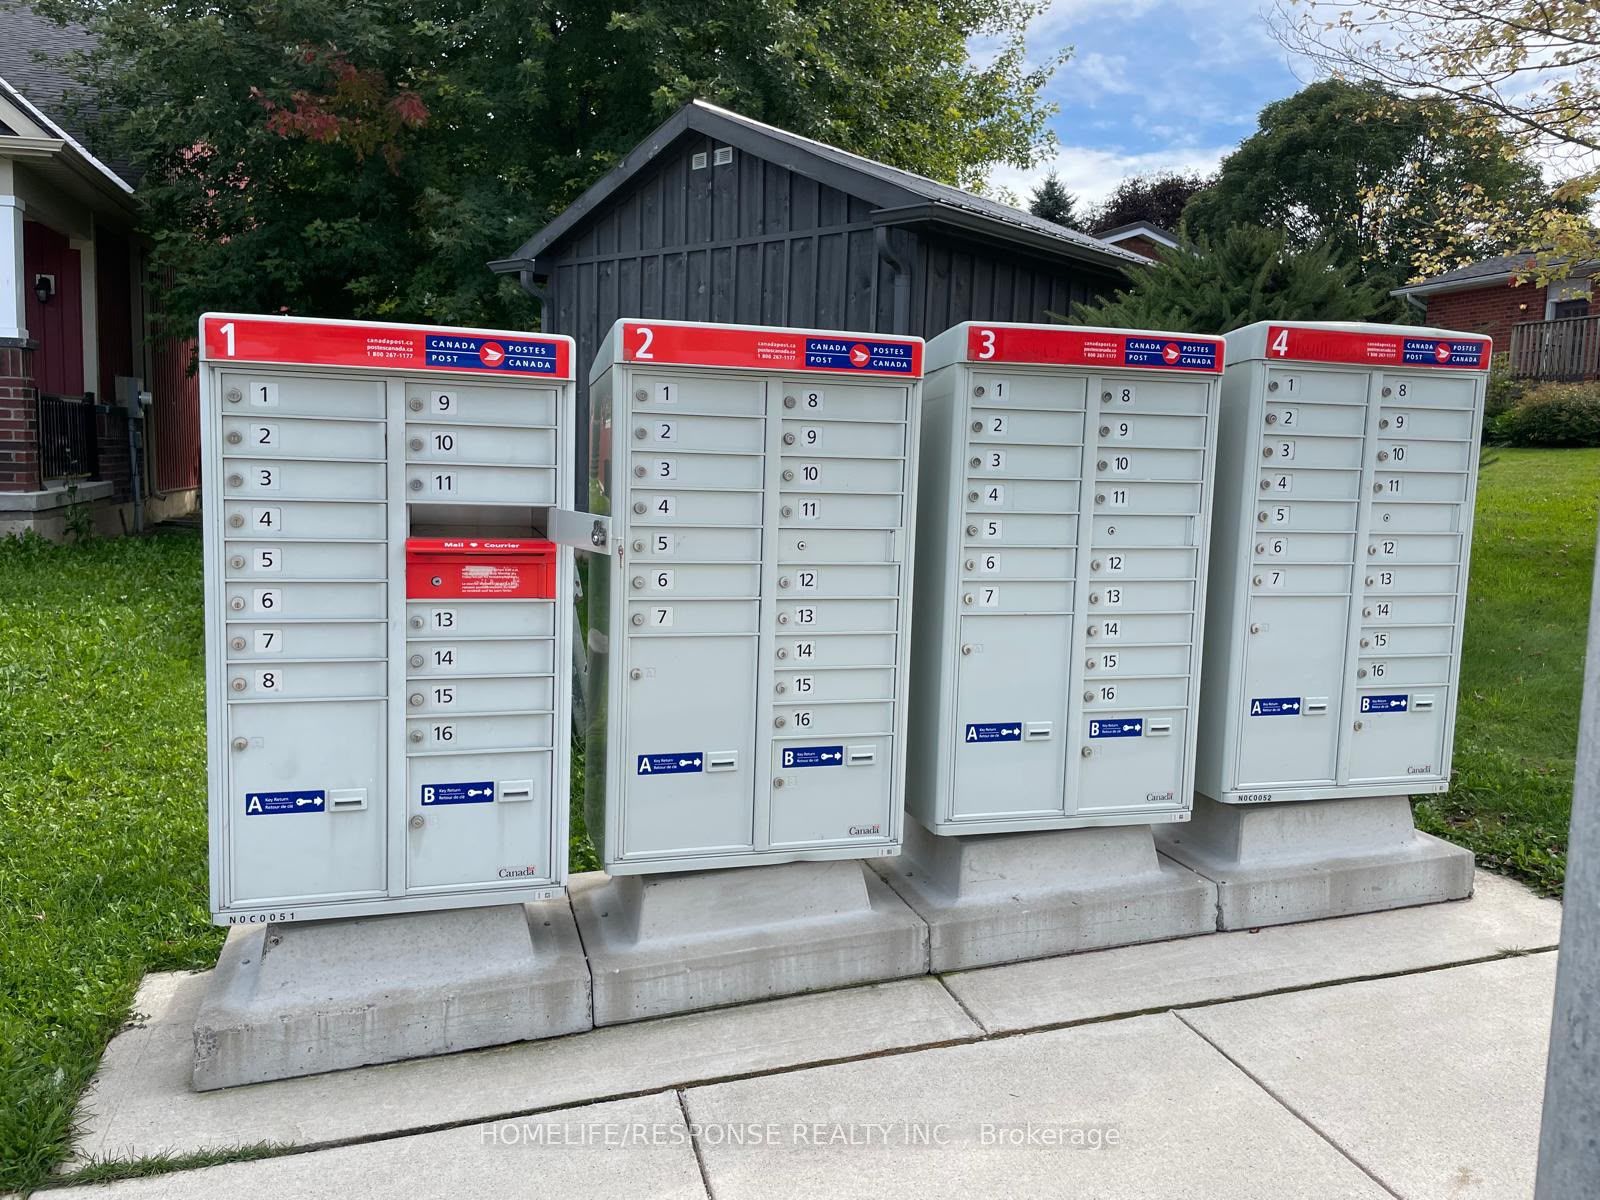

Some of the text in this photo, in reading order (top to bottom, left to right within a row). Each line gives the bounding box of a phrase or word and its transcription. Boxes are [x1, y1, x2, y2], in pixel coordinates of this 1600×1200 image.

[219, 322, 235, 356] 1
[366, 338, 414, 346] canadapost.ca
[431, 340, 476, 350] CANADA
[635, 327, 654, 359] 2
[979, 330, 995, 359] 3
[1129, 342, 1161, 350] CANADA
[1272, 330, 1288, 356] 4
[1406, 342, 1434, 350] CANADA
[508, 345, 546, 355] POSTES
[810, 343, 847, 351] CANADA
[873, 347, 904, 355] POSTES
[1183, 345, 1209, 353] POSTES
[432, 354, 458, 363] POST
[508, 359, 551, 369] CANADA
[810, 356, 832, 364] POST
[873, 360, 908, 368] CANADA
[1182, 357, 1211, 365] CANADA
[996, 383, 1002, 397] 1
[1288, 378, 1294, 391] 1
[1398, 383, 1407, 397] 8
[260, 386, 267, 403] 1
[663, 386, 669, 401] 1
[807, 393, 818, 408] 8
[1121, 388, 1131, 403] 8
[438, 395, 450, 411] 9
[993, 418, 1002, 432] 2
[1284, 411, 1293, 425] 2
[1396, 415, 1404, 429] 9
[259, 427, 271, 444] 2
[660, 424, 671, 439] 2
[807, 429, 817, 444] 9
[1119, 423, 1128, 437] 9
[435, 434, 454, 451] 10
[1281, 443, 1290, 457] 3
[1392, 447, 1405, 461] 10
[991, 453, 1001, 467] 3
[1115, 456, 1129, 471] 10
[660, 462, 670, 477] 3
[803, 466, 818, 481] 10
[260, 469, 272, 486] 3
[435, 475, 451, 491] 11
[1278, 476, 1287, 489] 4
[1389, 479, 1399, 492] 11
[988, 487, 998, 502] 4
[1113, 490, 1125, 504] 11
[658, 499, 670, 514] 4
[802, 502, 816, 517] 11
[259, 511, 273, 527] 4
[1276, 508, 1285, 522] 5
[988, 522, 997, 536] 5
[658, 536, 668, 551] 5
[1274, 540, 1282, 553] 6
[1383, 541, 1395, 554] 12
[262, 551, 273, 568] 5
[986, 556, 995, 570] 6
[1109, 556, 1122, 570] 12
[658, 572, 668, 587] 6
[799, 573, 814, 587] 12
[1272, 572, 1280, 585] 7
[1380, 572, 1392, 585] 13
[261, 592, 274, 609] 6
[985, 589, 994, 604] 7
[1106, 589, 1120, 603] 13
[657, 609, 667, 624] 7
[798, 608, 813, 623] 13
[1377, 603, 1389, 616] 14
[435, 612, 453, 627] 13
[1104, 622, 1118, 636] 14
[262, 633, 274, 649] 7
[1375, 634, 1387, 647] 15
[797, 643, 813, 657] 14
[434, 650, 454, 666] 14
[1103, 655, 1117, 668] 15
[1372, 664, 1384, 677] 16
[262, 672, 275, 689] 8
[795, 678, 811, 692] 15
[434, 688, 453, 704] 15
[1101, 687, 1115, 700] 16
[1251, 700, 1262, 714] A
[1362, 698, 1370, 711] B
[794, 712, 810, 726] 16
[434, 726, 453, 741] 16
[967, 726, 978, 741] A
[1091, 722, 1100, 736] B
[639, 757, 652, 773] A
[784, 751, 794, 766] B
[424, 787, 435, 803] B
[1146, 792, 1173, 802] Canada
[248, 796, 263, 813] A
[848, 825, 879, 836] Canada
[498, 866, 535, 878] Canada
